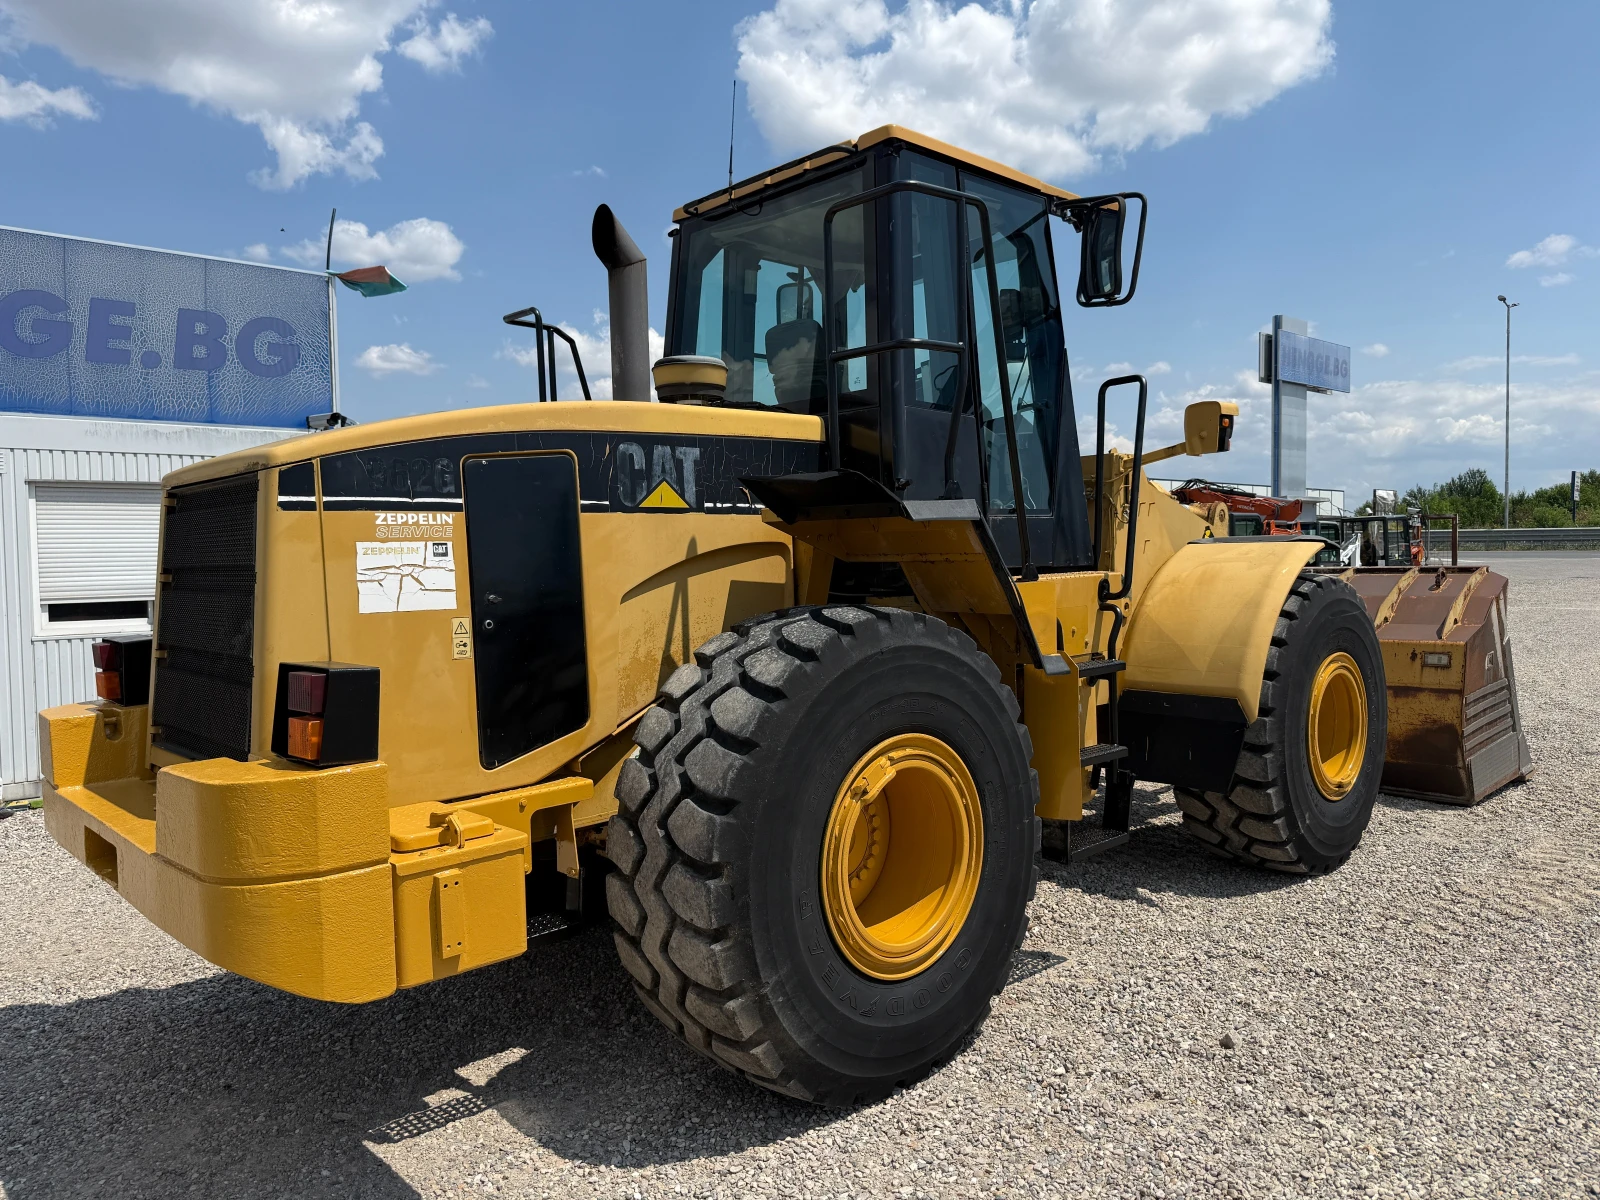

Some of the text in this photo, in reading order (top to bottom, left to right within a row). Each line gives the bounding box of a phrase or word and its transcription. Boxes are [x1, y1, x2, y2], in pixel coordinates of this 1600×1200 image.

[0, 289, 300, 378] GE.BG
[617, 442, 700, 508] CAT
[374, 513, 454, 525] ZEPPELIN
[375, 526, 454, 538] SERVICE
[362, 546, 419, 556] ZEPPELIN
[433, 544, 447, 553] CAT
